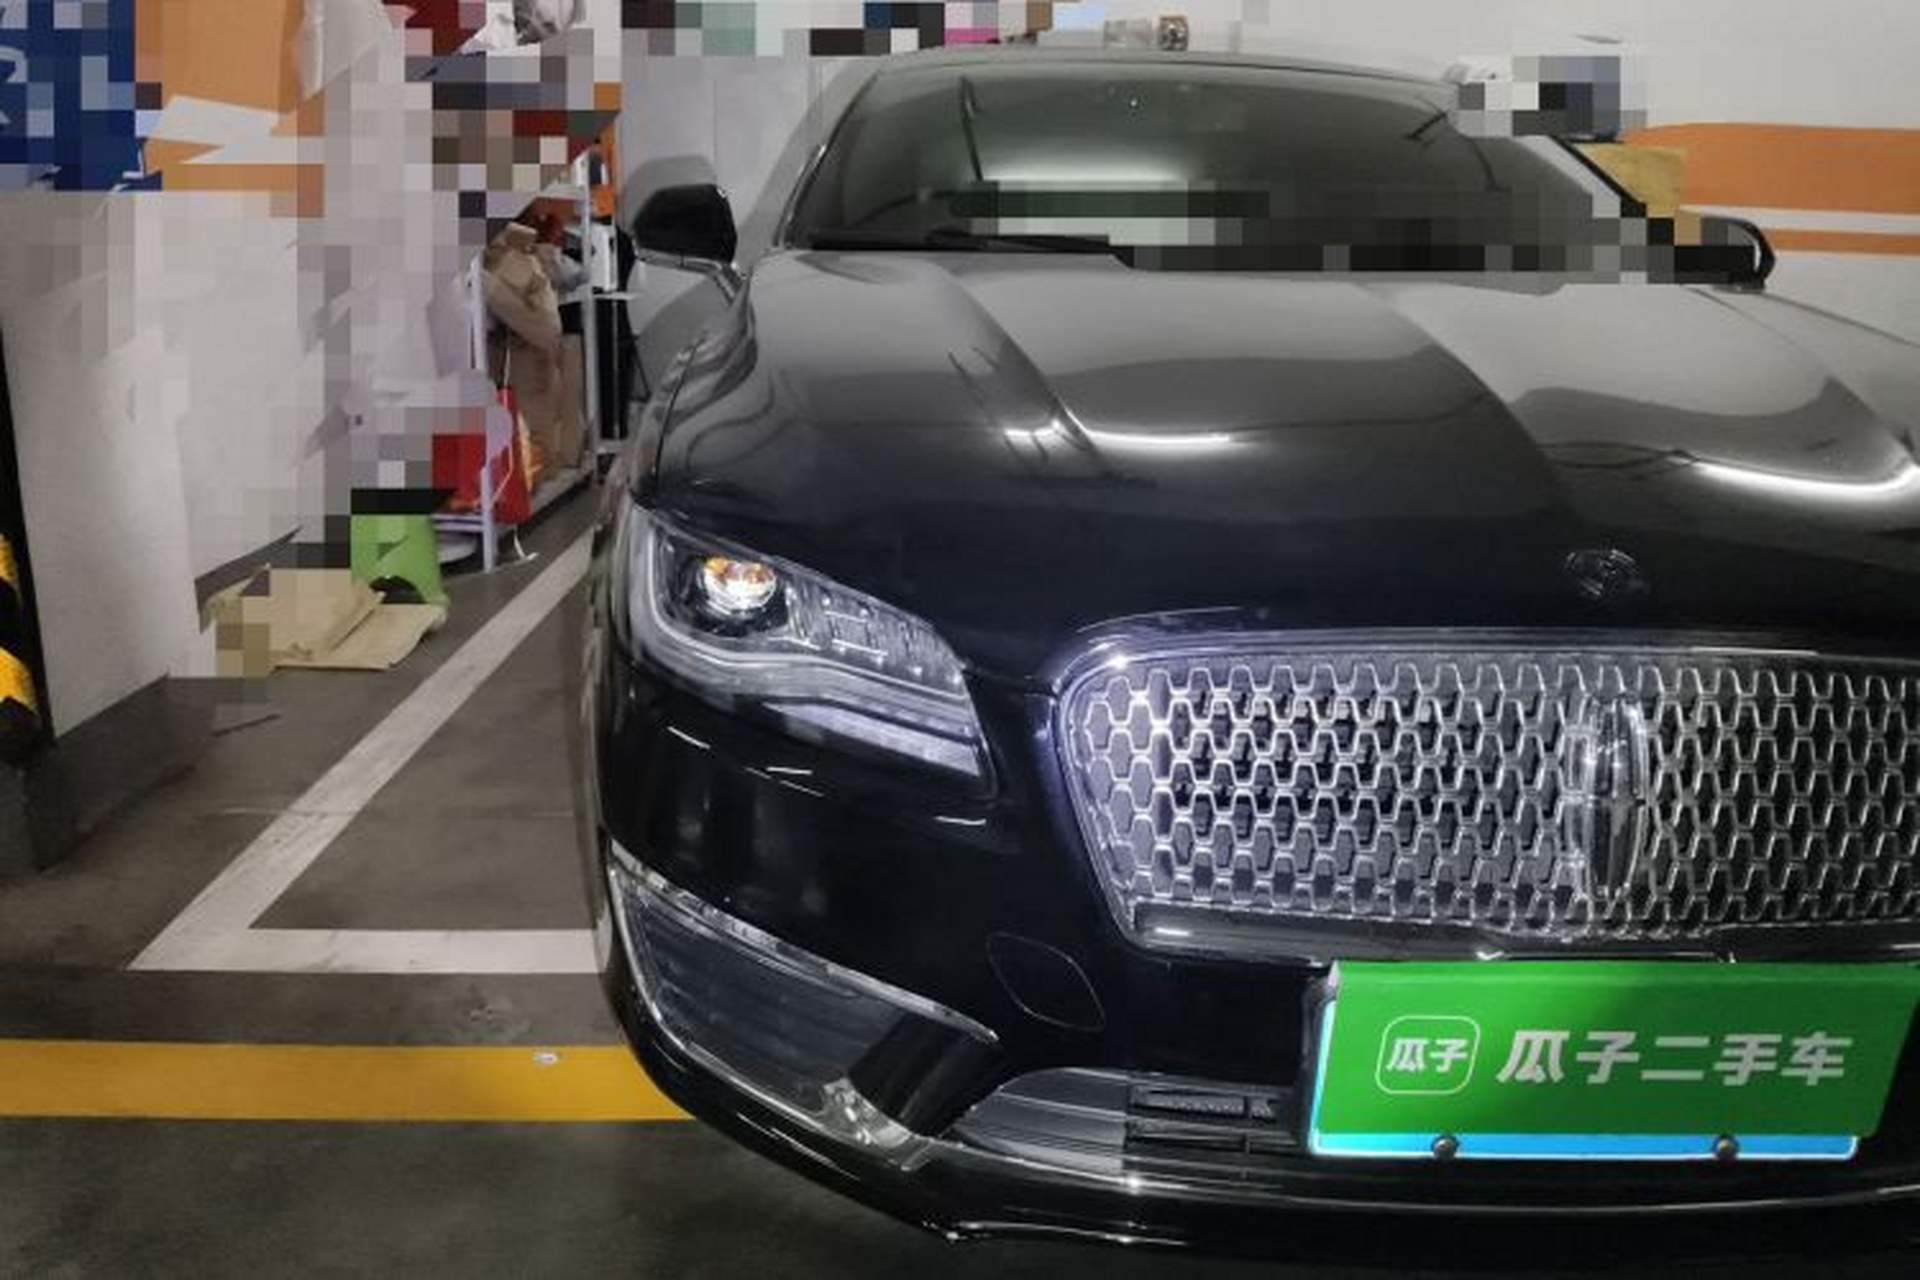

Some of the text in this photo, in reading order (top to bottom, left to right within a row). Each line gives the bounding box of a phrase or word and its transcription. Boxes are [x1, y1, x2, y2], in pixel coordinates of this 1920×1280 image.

[1385, 1038, 1469, 1073] 瓜子
[1495, 1029, 1853, 1086] 瓜子二手车
